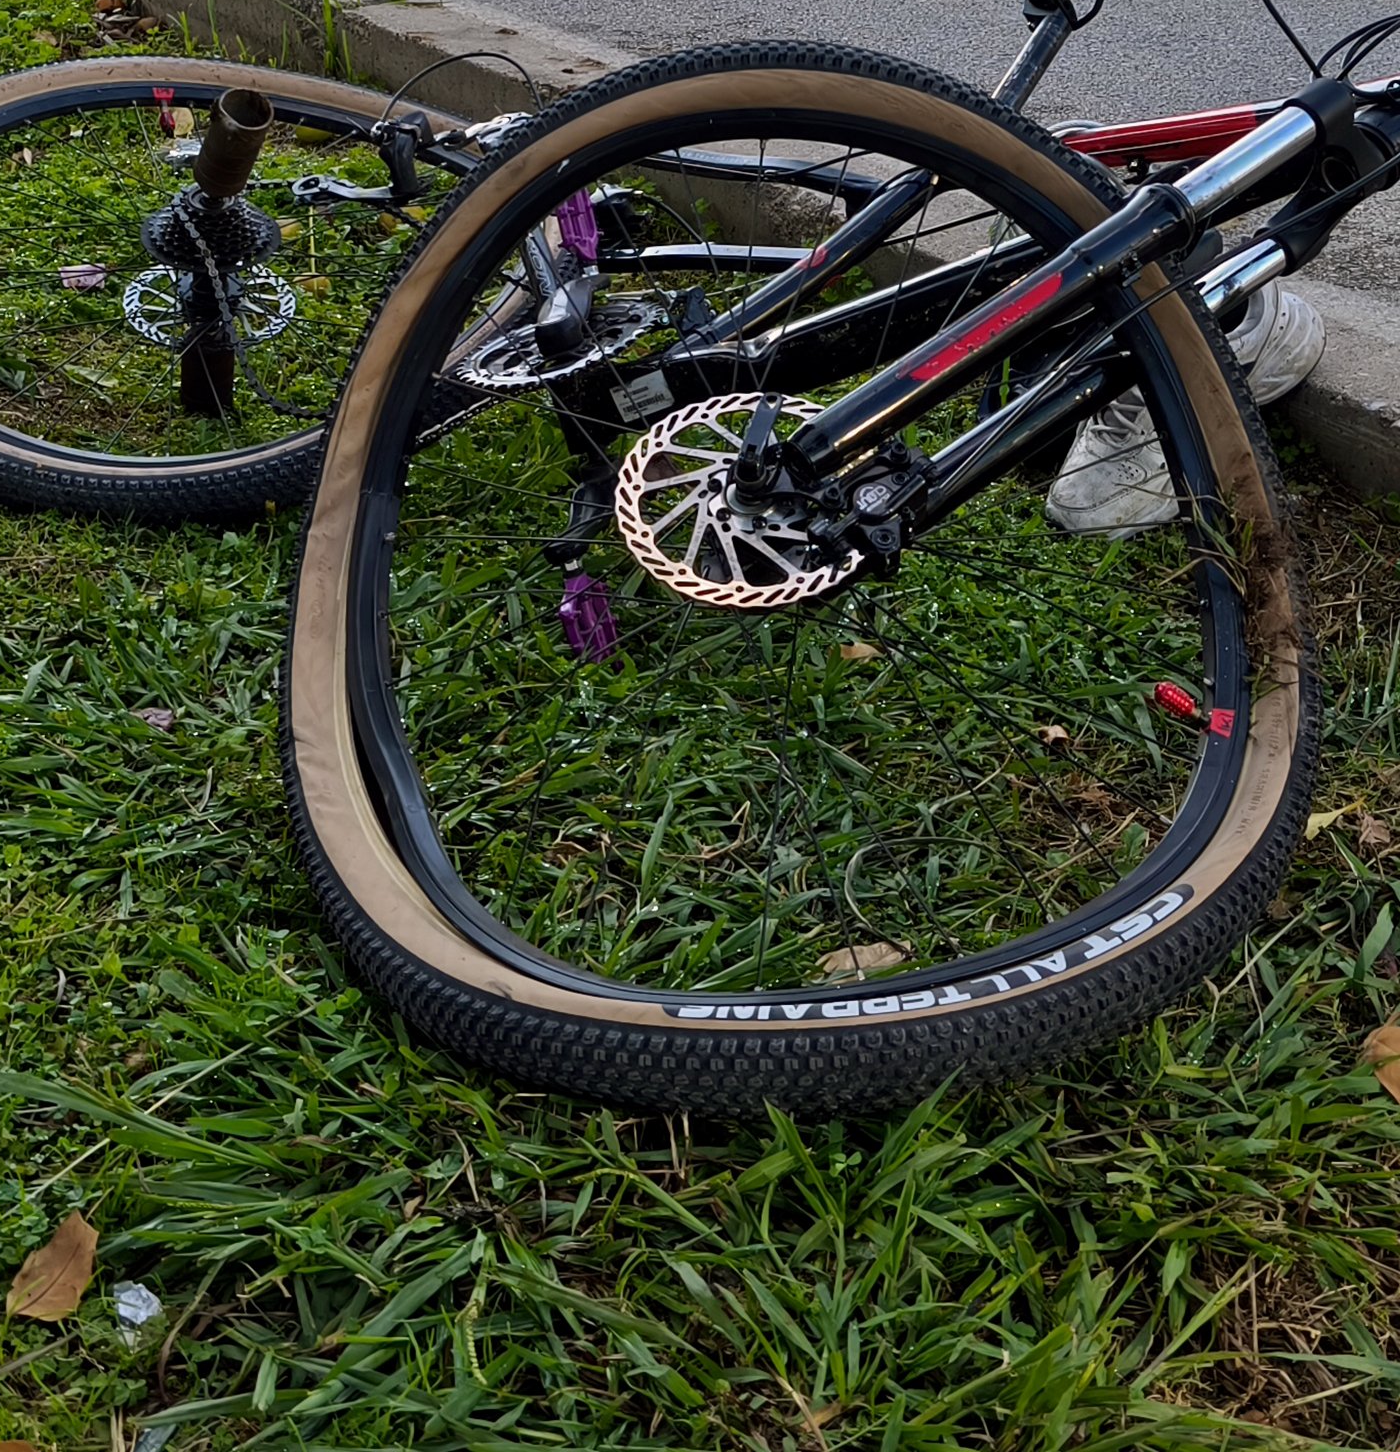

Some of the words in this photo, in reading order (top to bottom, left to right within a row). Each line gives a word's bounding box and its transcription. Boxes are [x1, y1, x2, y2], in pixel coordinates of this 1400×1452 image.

[1084, 892, 1185, 961] CST
[970, 950, 1067, 992] ALL
[677, 984, 972, 1019] TERRAINS
